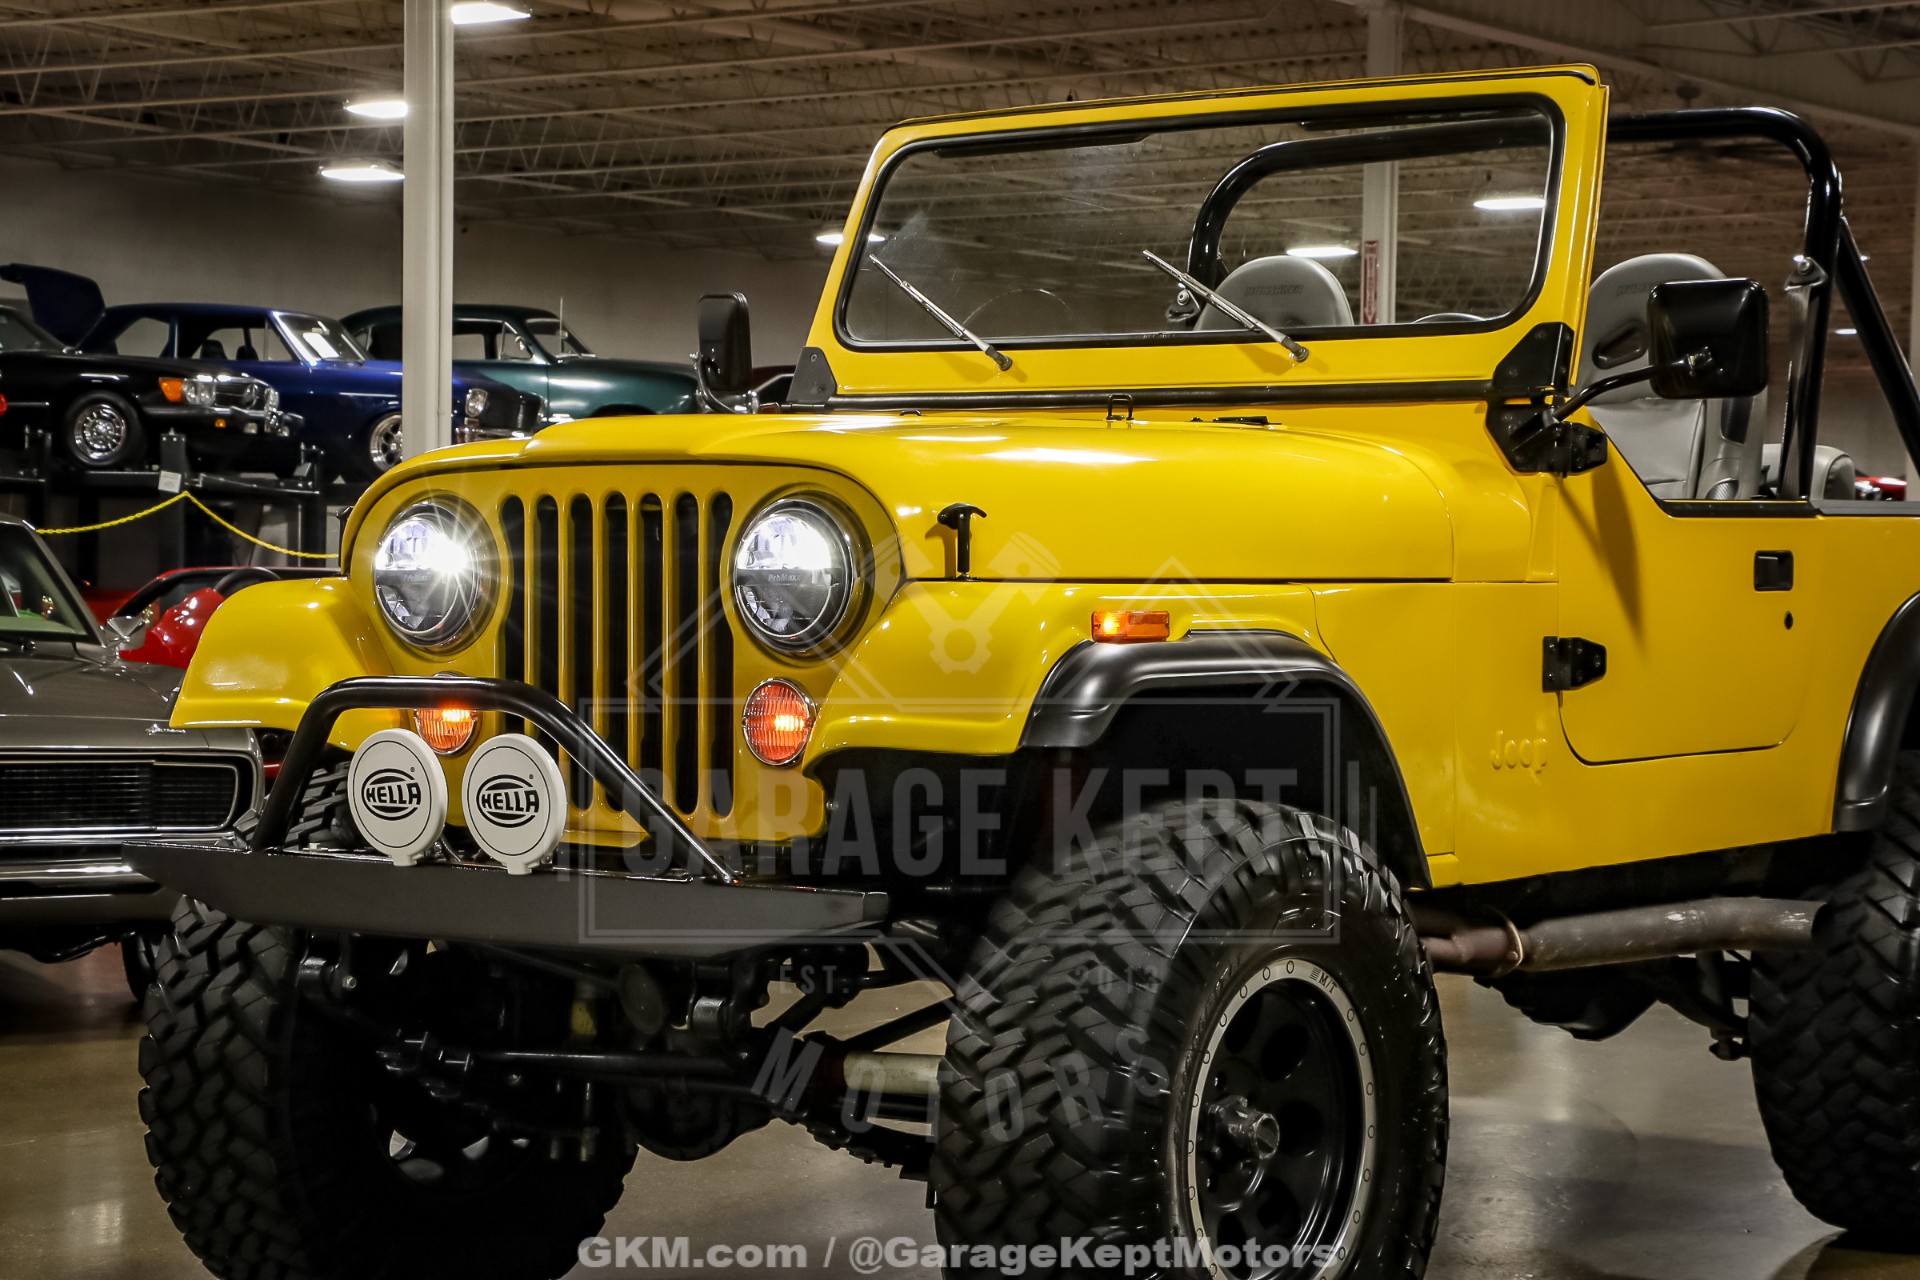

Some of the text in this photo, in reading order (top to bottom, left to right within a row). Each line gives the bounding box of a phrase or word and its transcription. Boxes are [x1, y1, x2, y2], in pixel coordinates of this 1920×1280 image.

[1489, 730, 1549, 774] Jeep
[366, 782, 422, 806] HELLA
[481, 789, 540, 814] HELLA
[1318, 971, 1338, 994] M/T
